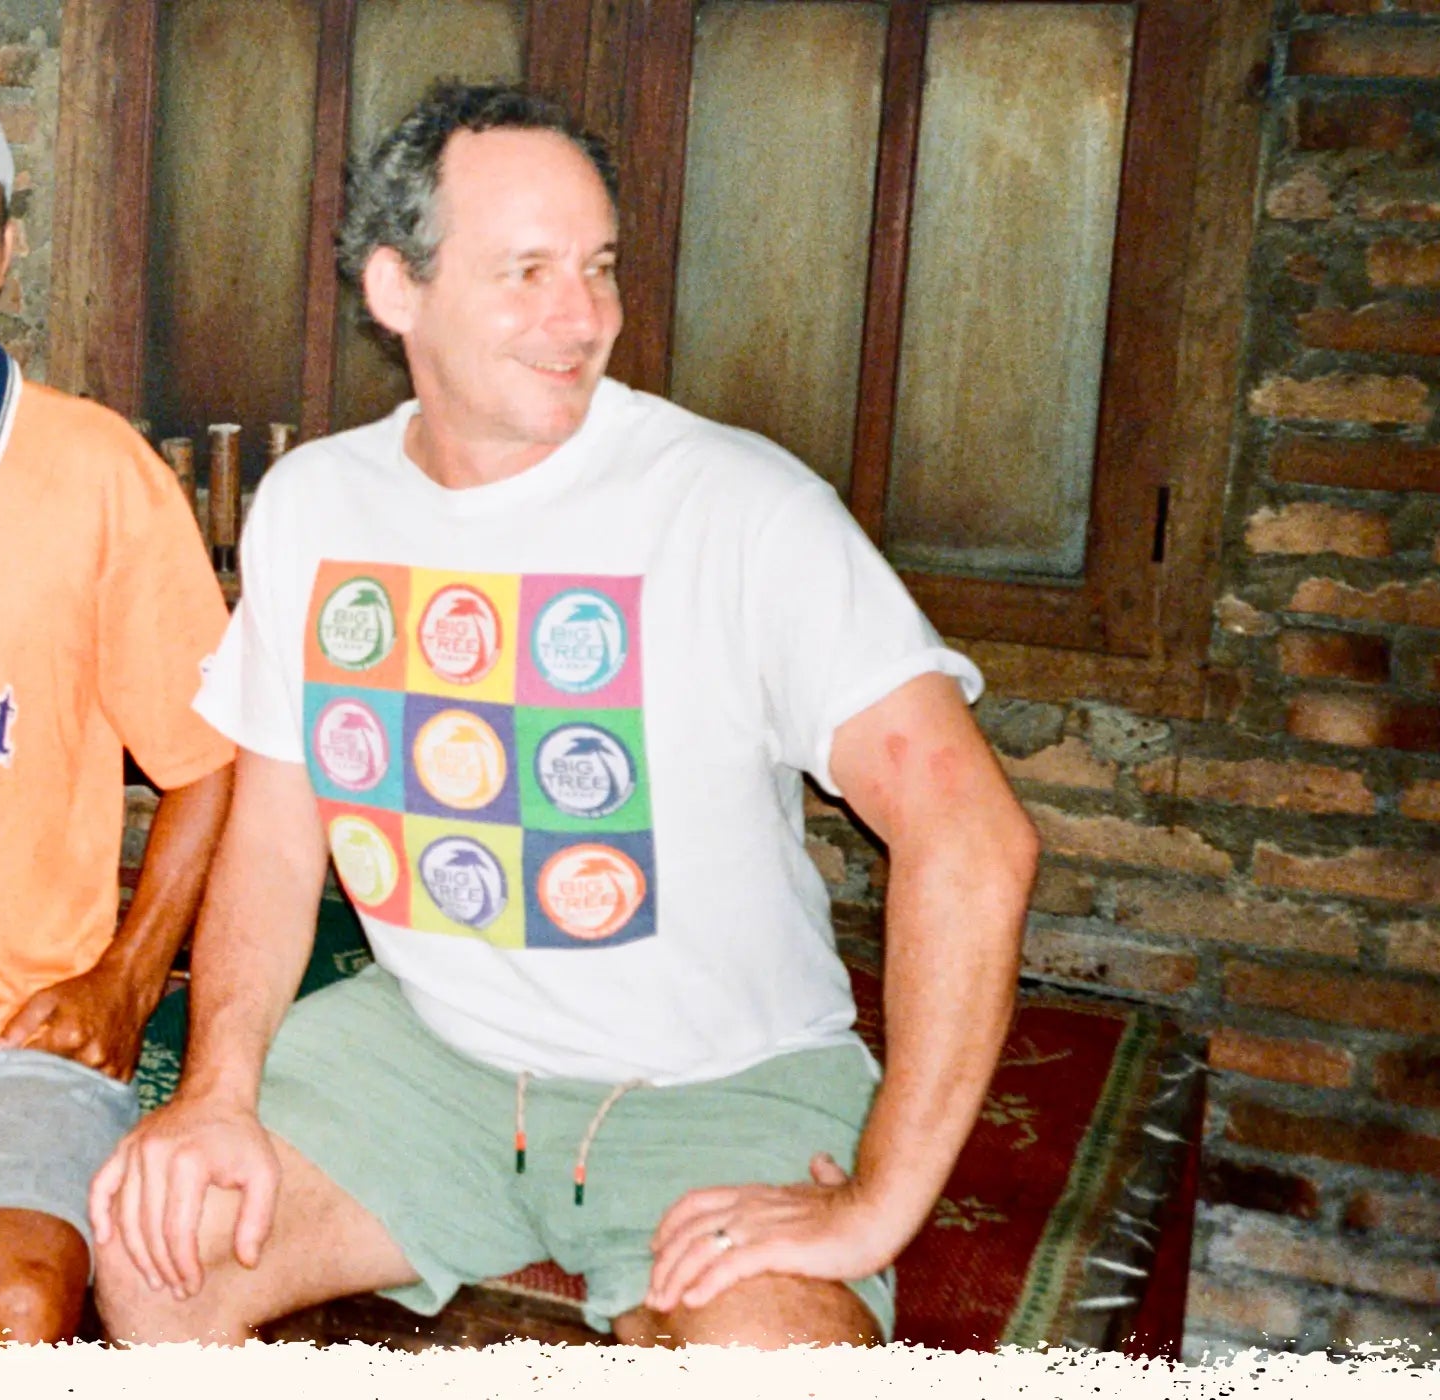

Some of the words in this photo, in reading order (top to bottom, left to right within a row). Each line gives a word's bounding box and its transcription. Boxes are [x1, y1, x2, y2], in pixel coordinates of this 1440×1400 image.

[333, 609, 369, 626] BIG
[325, 624, 376, 642] TREE
[435, 619, 469, 636] BIG
[550, 626, 593, 642] BIG
[423, 634, 479, 655] TREE
[541, 642, 602, 661] TREE
[552, 757, 594, 776] BIG
[543, 772, 607, 791] TREE
[433, 868, 470, 887] BIG
[560, 880, 603, 896] BIG
[553, 892, 616, 910] TREE
